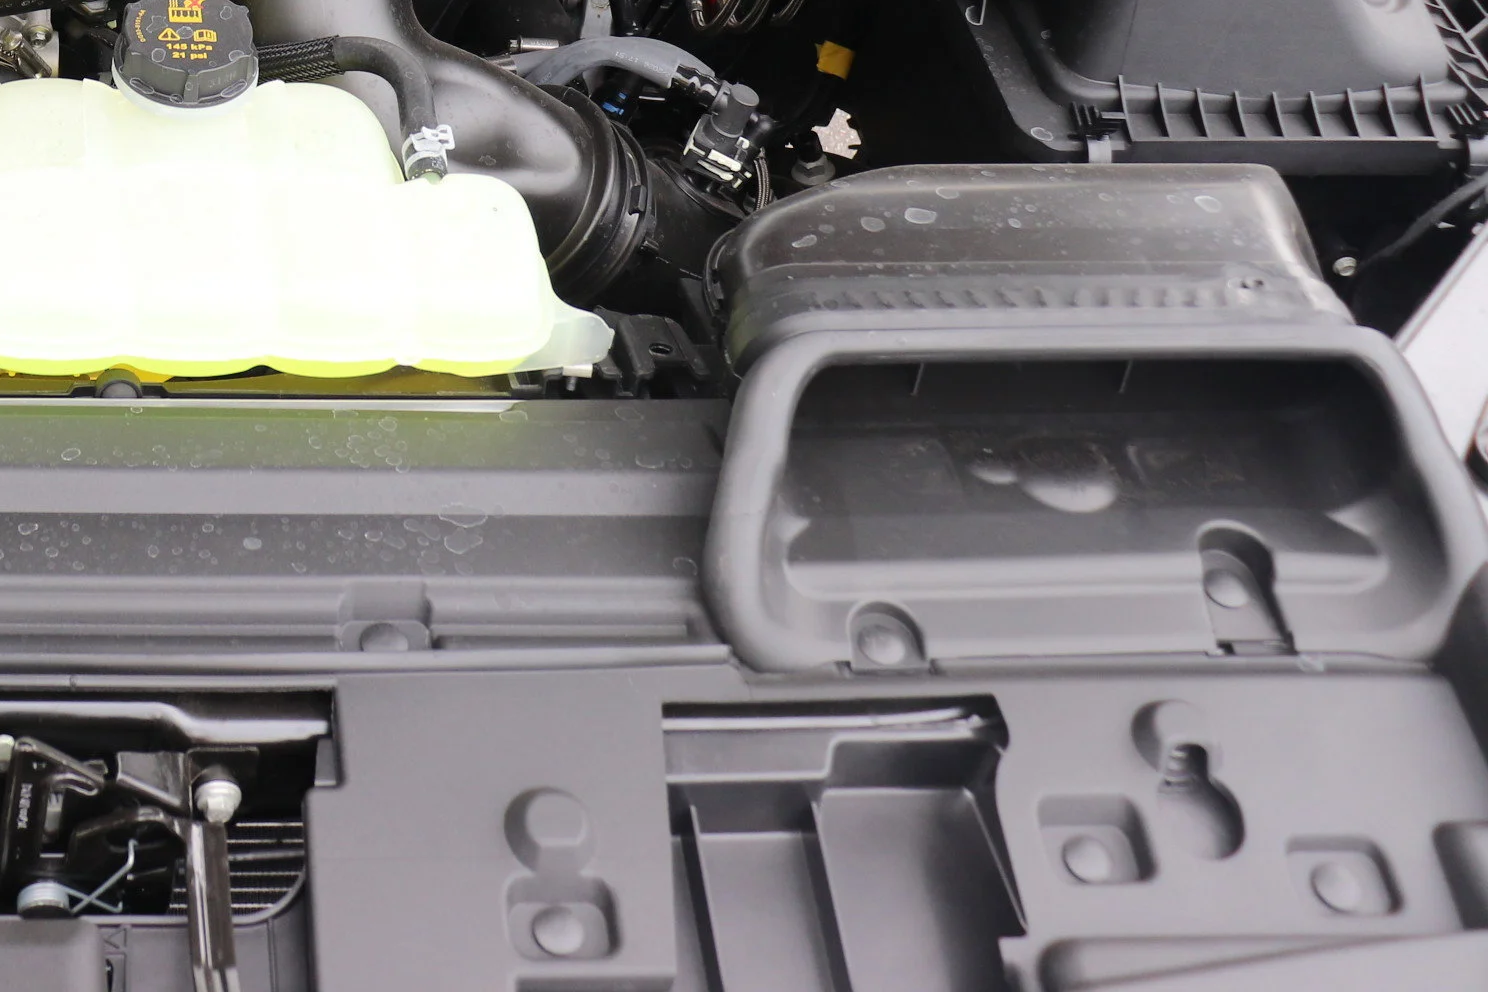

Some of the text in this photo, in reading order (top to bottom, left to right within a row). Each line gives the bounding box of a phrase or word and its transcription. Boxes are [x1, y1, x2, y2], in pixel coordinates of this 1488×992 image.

[166, 43, 213, 51] 145 kPa
[190, 52, 208, 60] psi
